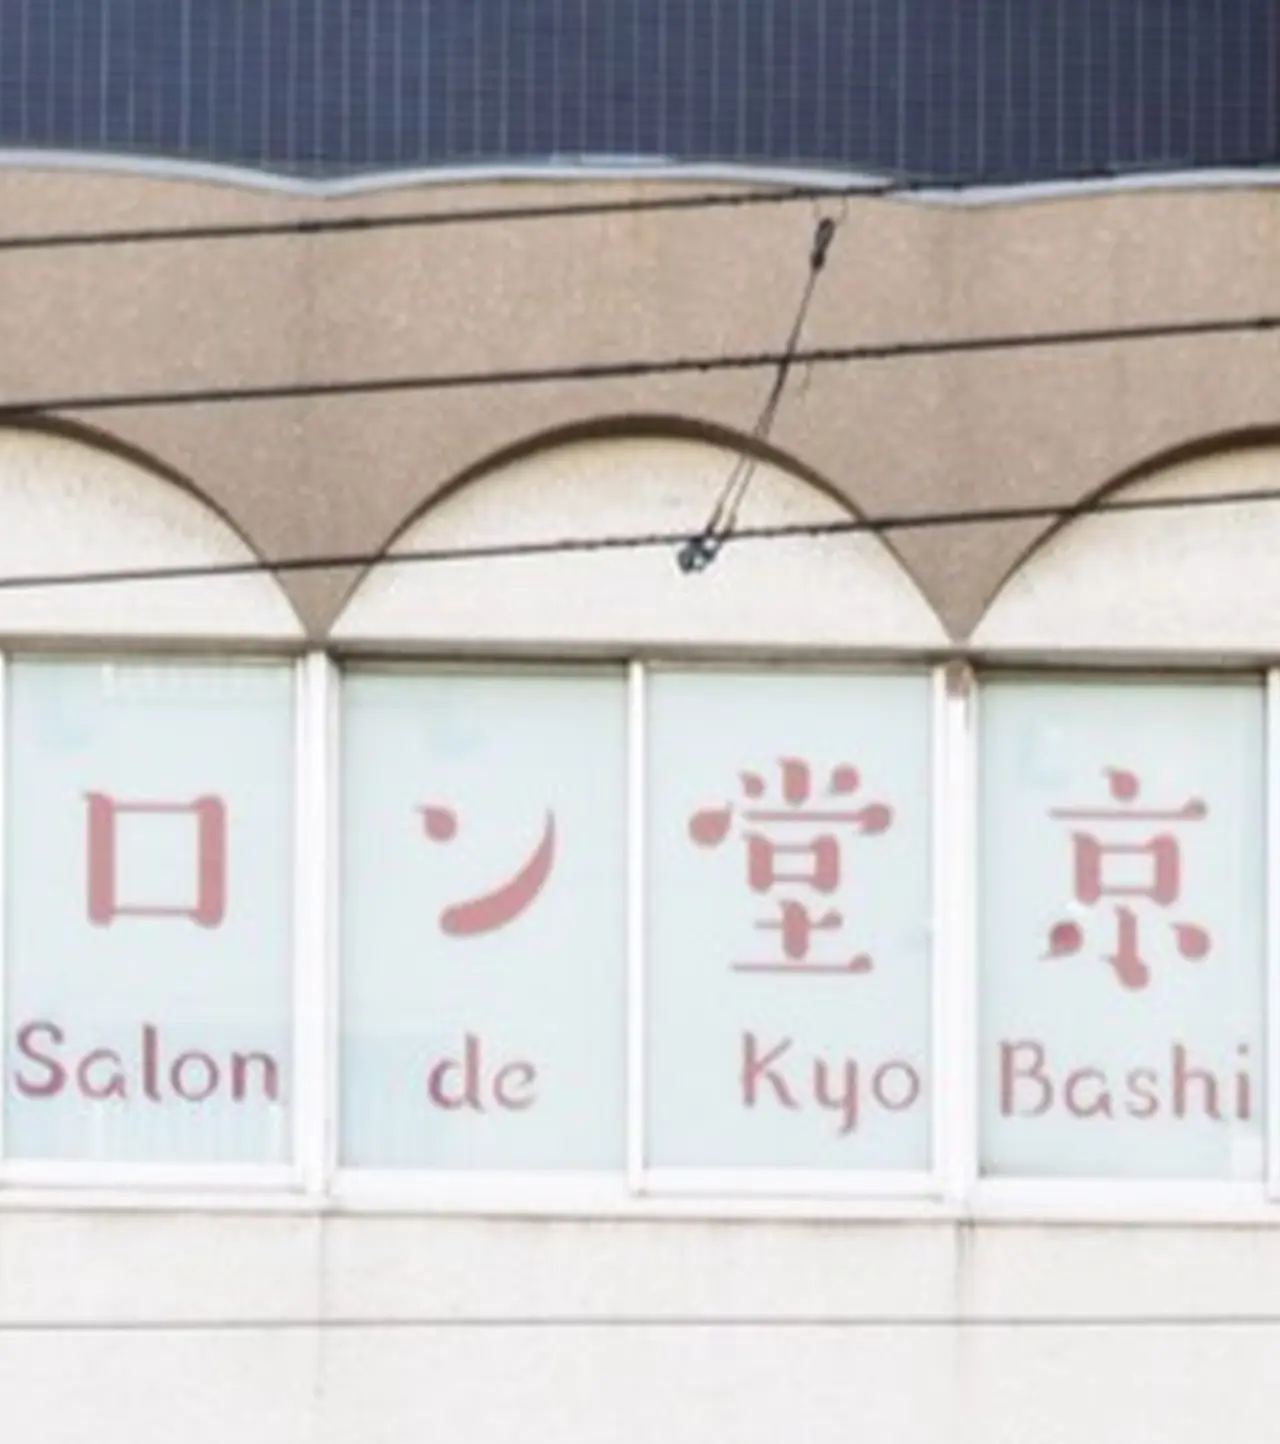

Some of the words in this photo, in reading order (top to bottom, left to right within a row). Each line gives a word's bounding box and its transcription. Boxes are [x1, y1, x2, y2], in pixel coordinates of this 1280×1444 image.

[12, 1020, 280, 1104] Salon
[424, 1034, 538, 1114] de
[738, 1032, 924, 1136] Kyo
[994, 1036, 1254, 1124] Bashi
